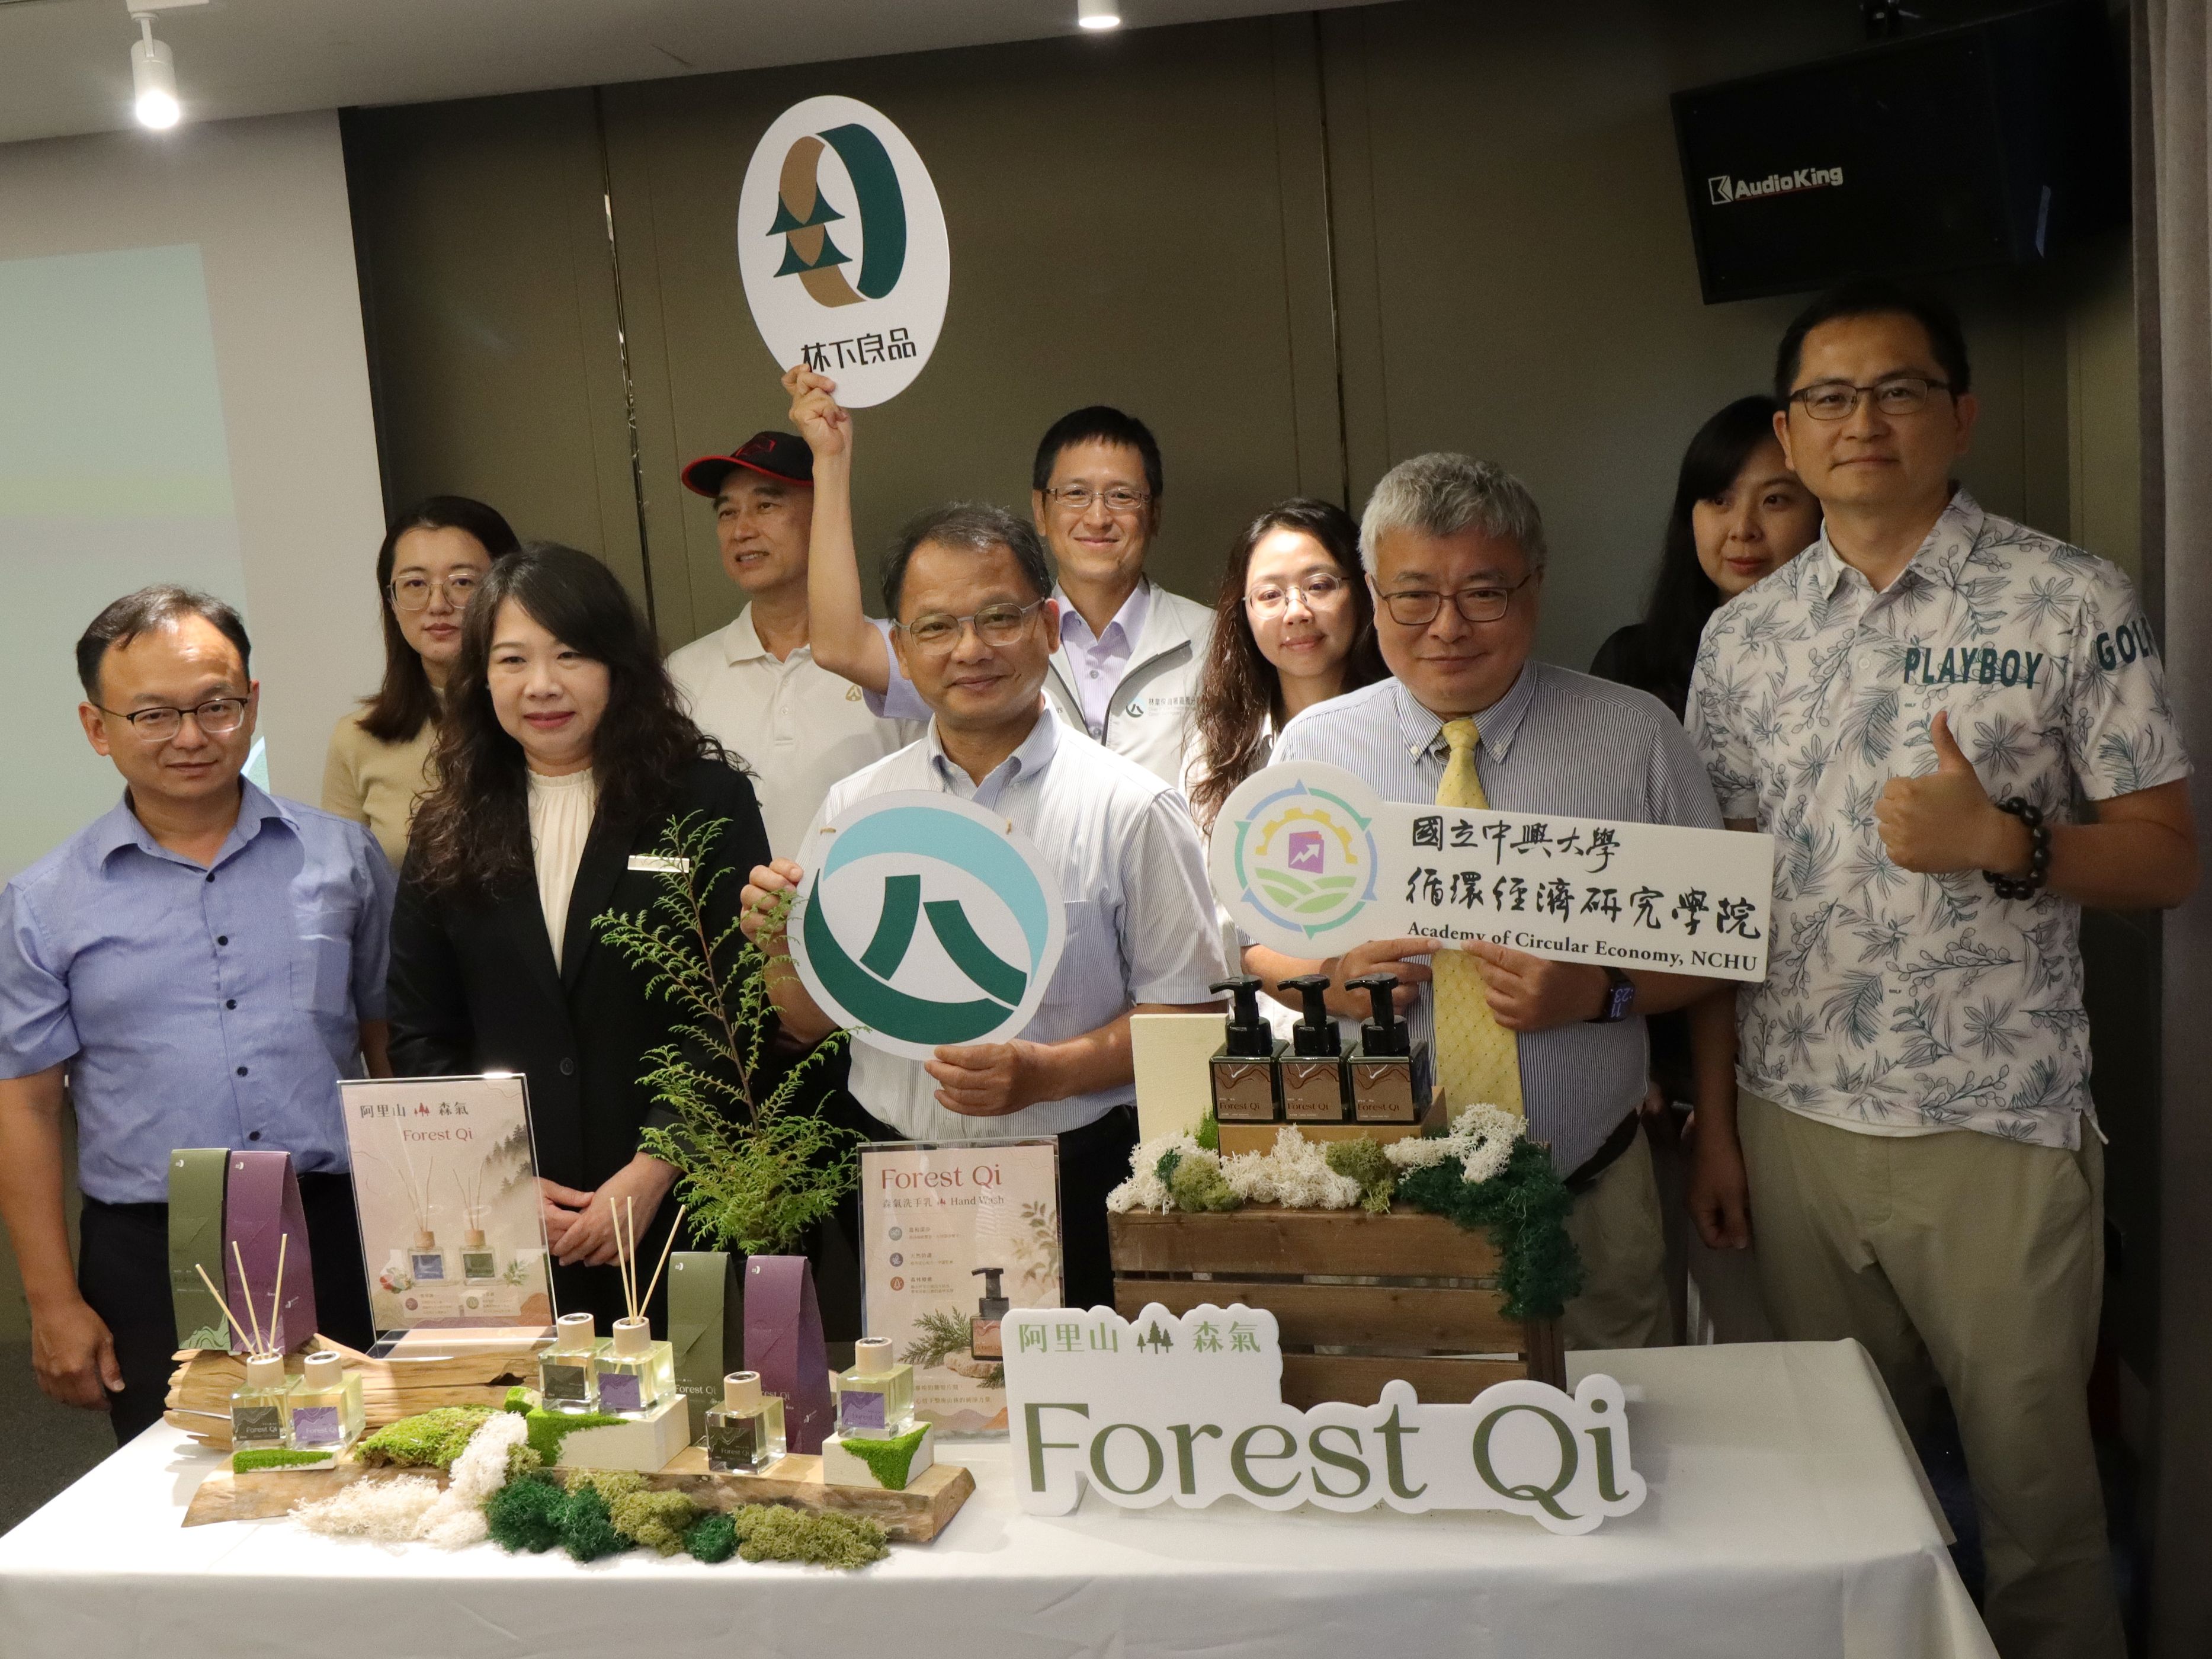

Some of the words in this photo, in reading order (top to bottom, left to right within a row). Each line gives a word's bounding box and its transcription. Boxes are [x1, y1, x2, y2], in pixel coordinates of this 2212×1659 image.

[1735, 167, 1844, 199] AudioKing
[801, 328, 916, 373] 林下良品
[1904, 648, 2043, 689] PLAYBOY
[1412, 815, 1620, 873] 國立中興大學
[1406, 866, 1761, 939] 循環經濟研究學院
[1408, 922, 1485, 940] Academy
[1492, 930, 1512, 945] of
[1515, 932, 1589, 953] Circular
[1595, 940, 1684, 967] Economy,
[1691, 952, 1758, 972] NCHU
[360, 1103, 406, 1119] 阿里山
[438, 1101, 469, 1116] 森氣
[403, 1129, 452, 1142] Forest
[456, 1128, 473, 1142] Qi
[881, 1166, 964, 1190] Forest
[972, 1164, 1002, 1189] Qi
[883, 1197, 932, 1208] 森氣洗手乳
[951, 1196, 976, 1206] Hand
[979, 1196, 1004, 1205] Wash
[1018, 1322, 1119, 1353] 阿里山
[1192, 1321, 1261, 1353] 森氣
[675, 1384, 704, 1394] Forest
[706, 1386, 716, 1397] Qi
[1024, 1402, 1428, 1500] Forest
[1472, 1398, 1630, 1521] Qi
